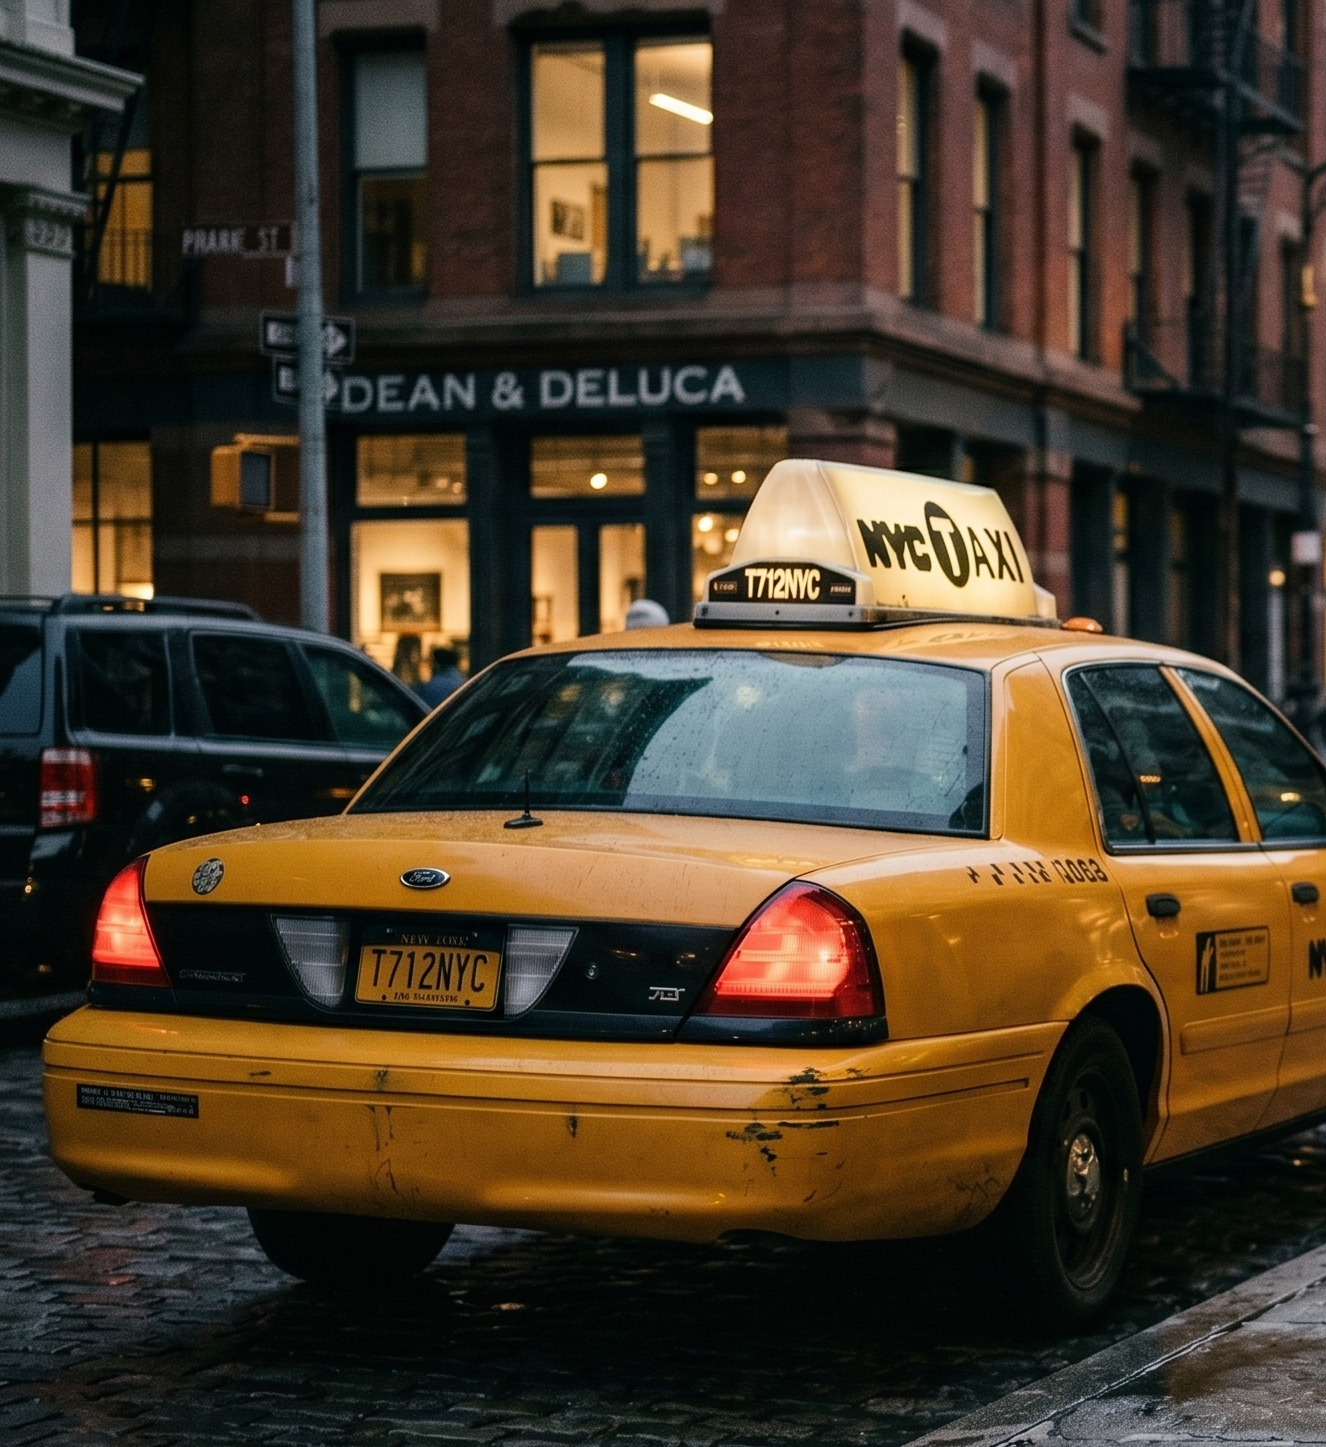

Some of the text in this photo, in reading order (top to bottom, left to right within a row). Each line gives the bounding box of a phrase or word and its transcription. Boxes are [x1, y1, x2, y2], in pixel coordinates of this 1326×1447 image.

[341, 373, 475, 412] DEAN
[491, 371, 524, 410] &
[539, 365, 745, 408] DELUCA
[857, 506, 1025, 585] NYC TAXI
[744, 568, 821, 601] T712NYC
[372, 948, 488, 993] T712NYC
